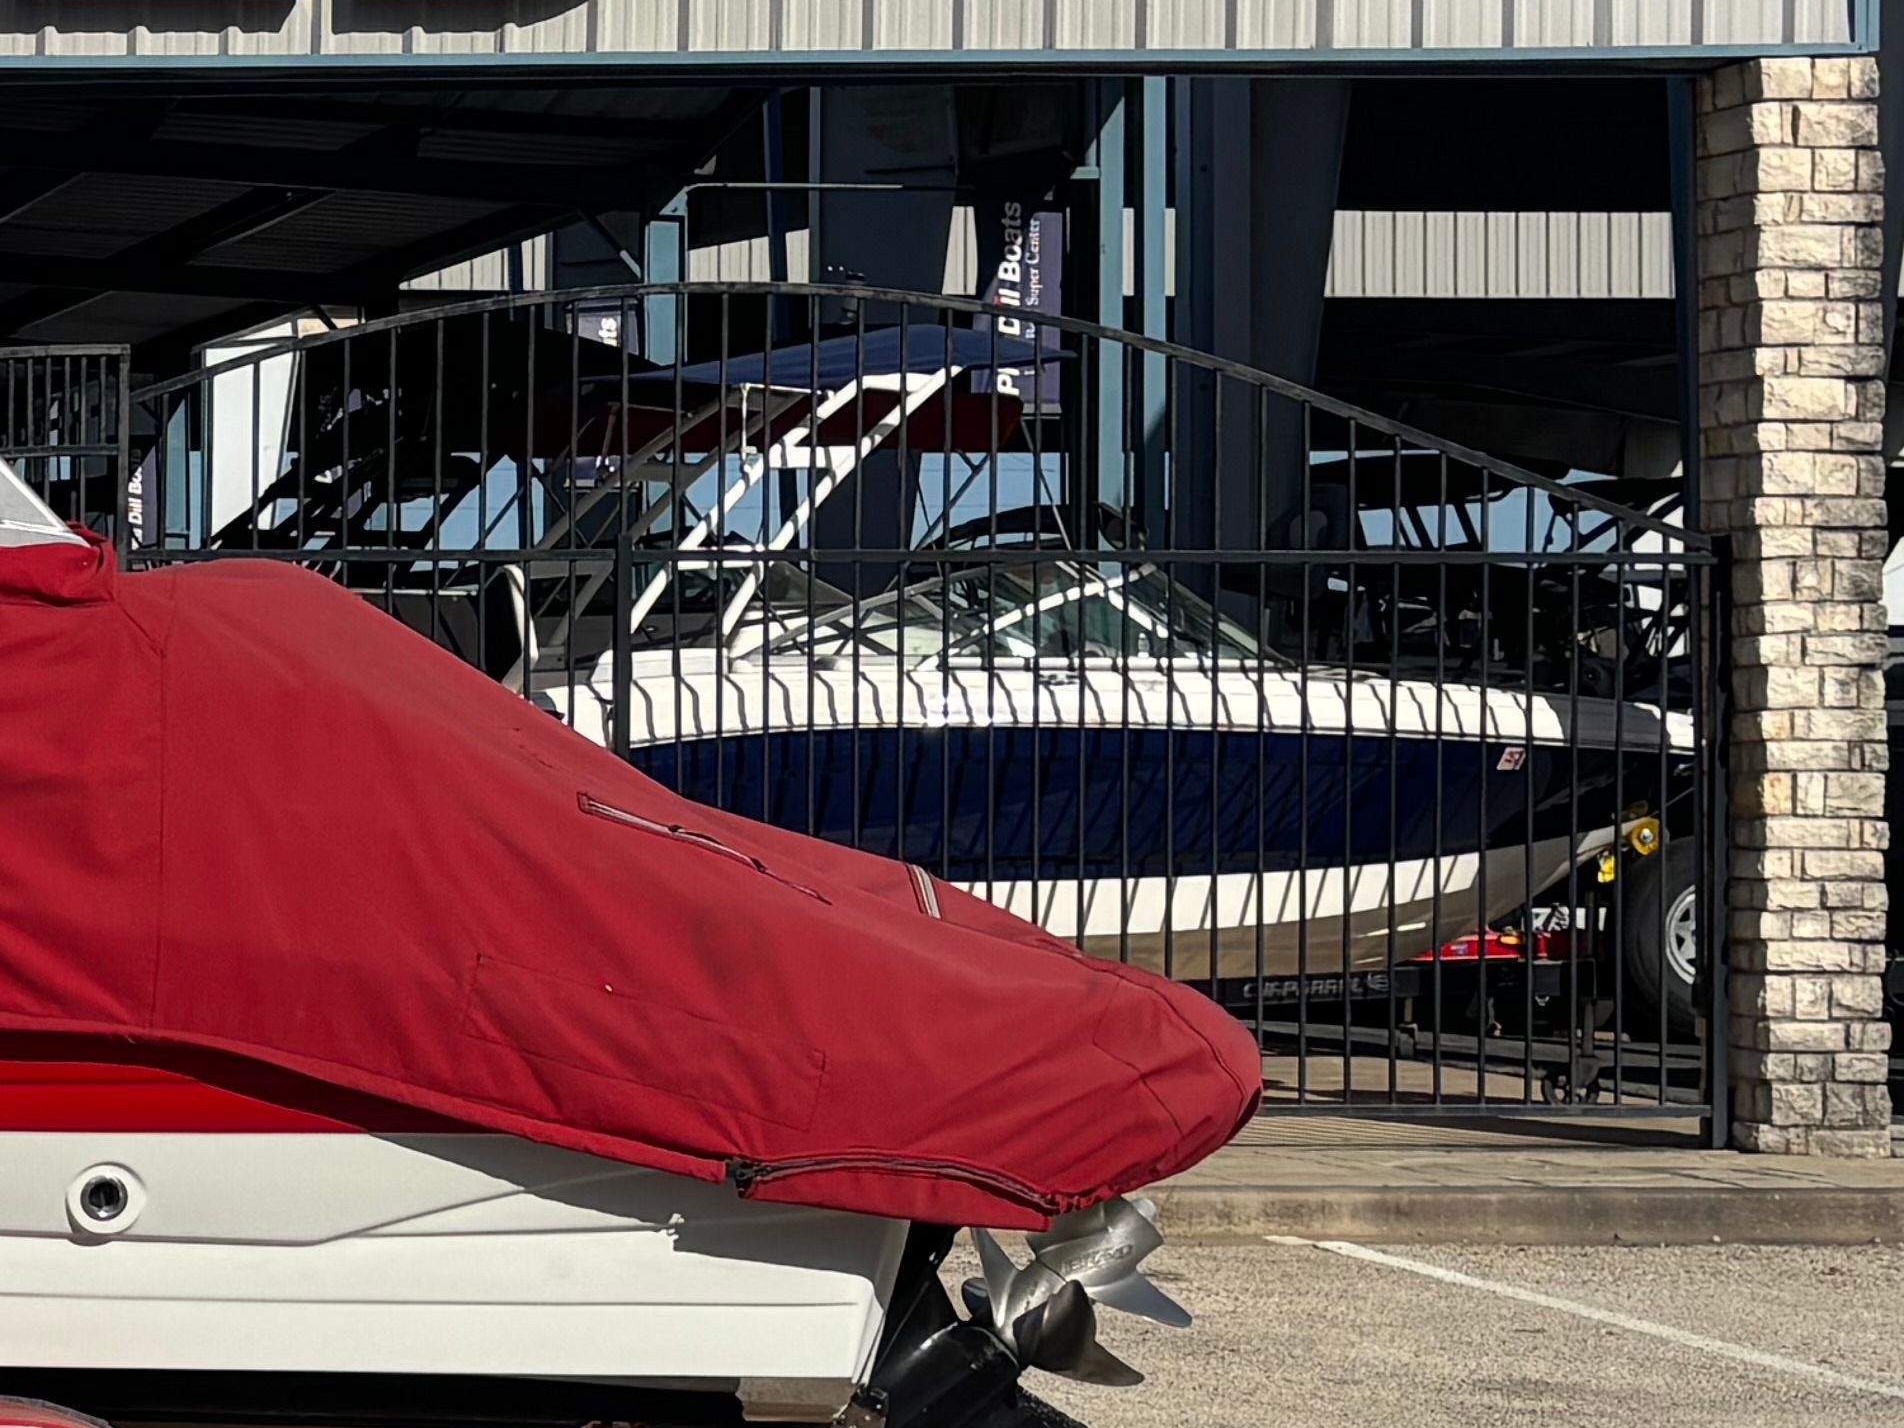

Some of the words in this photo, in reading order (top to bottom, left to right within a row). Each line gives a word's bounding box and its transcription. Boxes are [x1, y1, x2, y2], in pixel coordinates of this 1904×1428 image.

[998, 201, 1023, 283] Boats
[1024, 218, 1041, 264] Center
[1024, 267, 1043, 306] Super
[997, 289, 1021, 336] Dll
[127, 497, 143, 525] Dill
